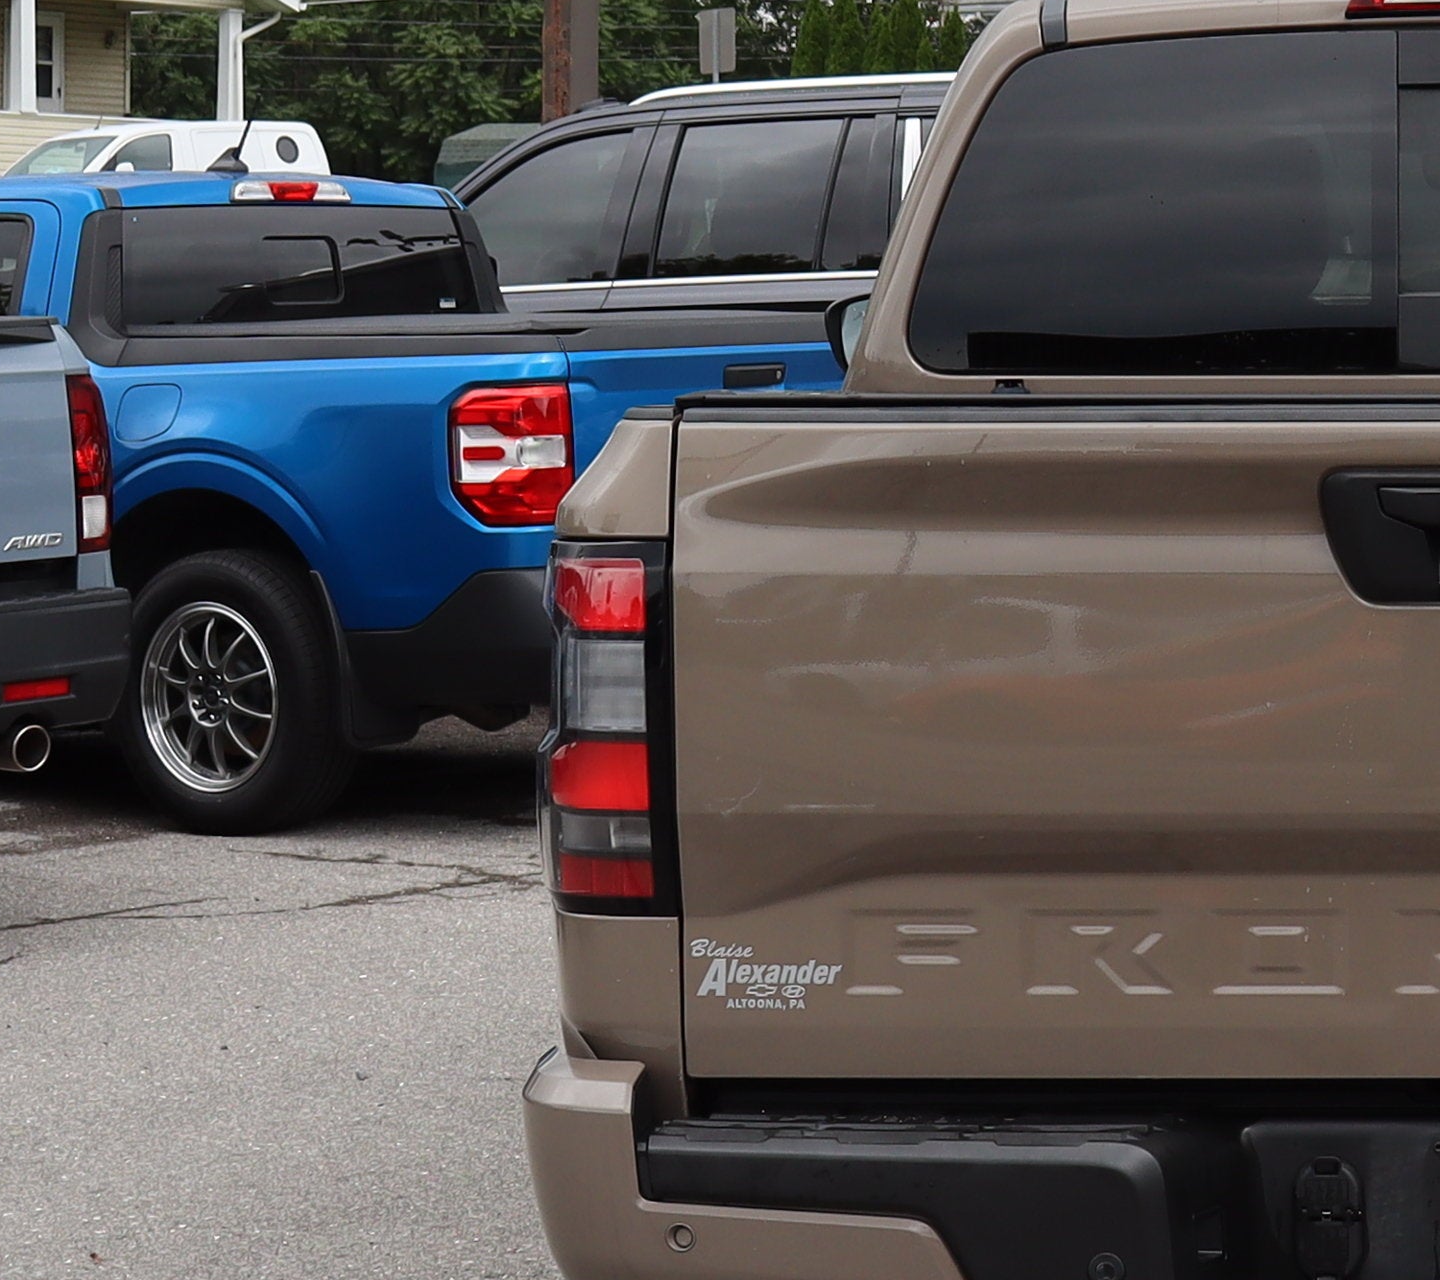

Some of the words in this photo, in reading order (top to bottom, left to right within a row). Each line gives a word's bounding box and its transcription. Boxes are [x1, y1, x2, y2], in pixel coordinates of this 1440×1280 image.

[3, 532, 62, 552] AWD
[690, 938, 754, 958] Blaise
[696, 957, 843, 997] Alexander
[726, 998, 786, 1011] ALTOONA,
[789, 998, 806, 1010] PA
